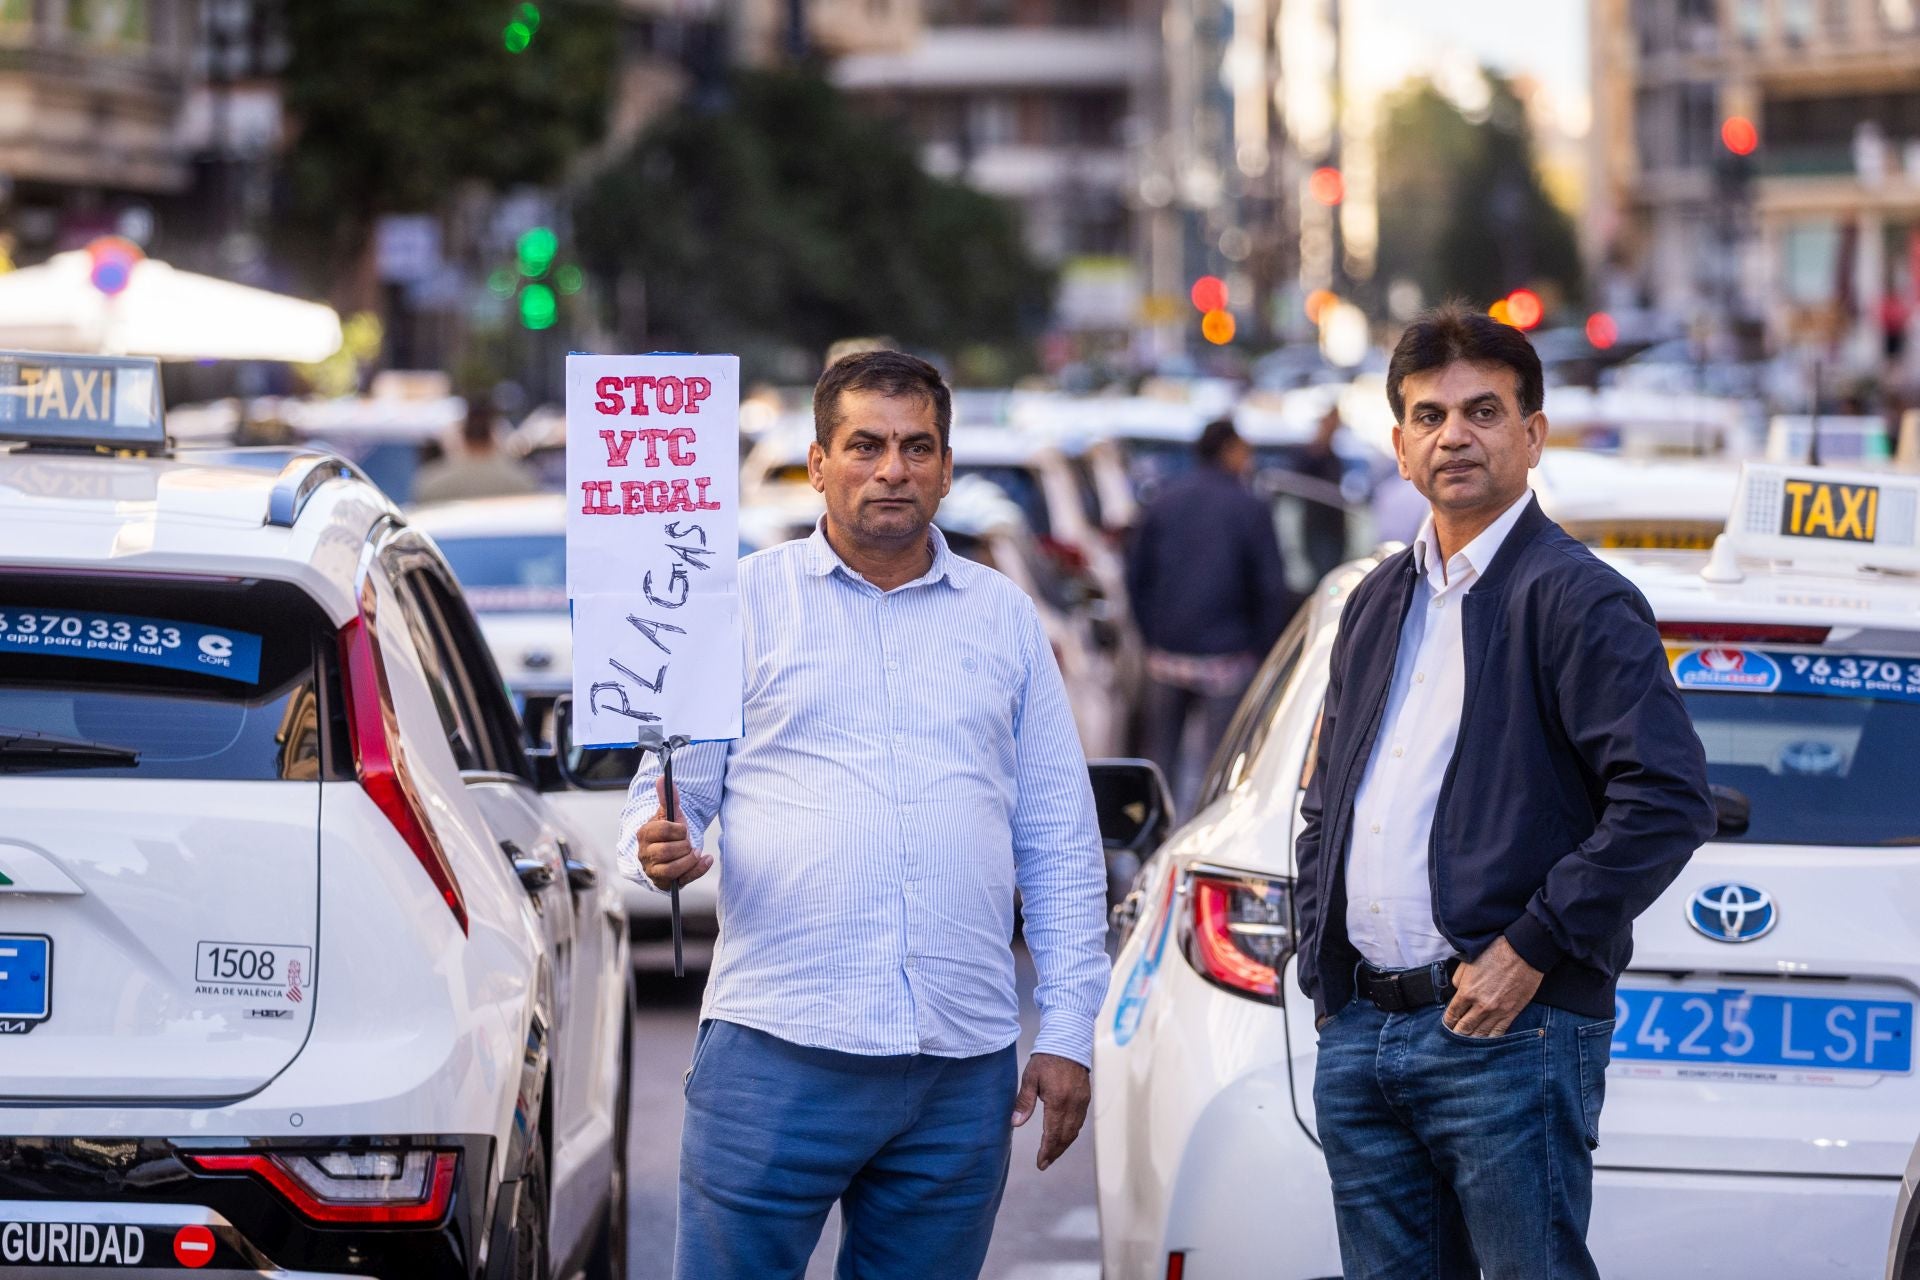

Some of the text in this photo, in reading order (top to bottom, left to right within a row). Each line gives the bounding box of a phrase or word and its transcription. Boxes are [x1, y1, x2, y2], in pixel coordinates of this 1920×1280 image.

[20, 368, 112, 420] TAXI
[595, 375, 712, 416] STOP
[600, 428, 696, 468] VTC
[581, 476, 721, 515] ILEGAL
[1785, 482, 1877, 540] TAXI
[16, 613, 83, 637] 370
[88, 619, 132, 642] 33
[138, 624, 181, 649] 33
[590, 520, 717, 722] PLAGAS
[6, 633, 162, 656] app para pedir taxi
[1791, 655, 1832, 676] 96
[1838, 658, 1902, 683] 370
[208, 947, 275, 981] 1508
[222, 987, 234, 995] DE
[1780, 1001, 1901, 1065] LSF
[1, 1222, 145, 1265] GURIDAD
